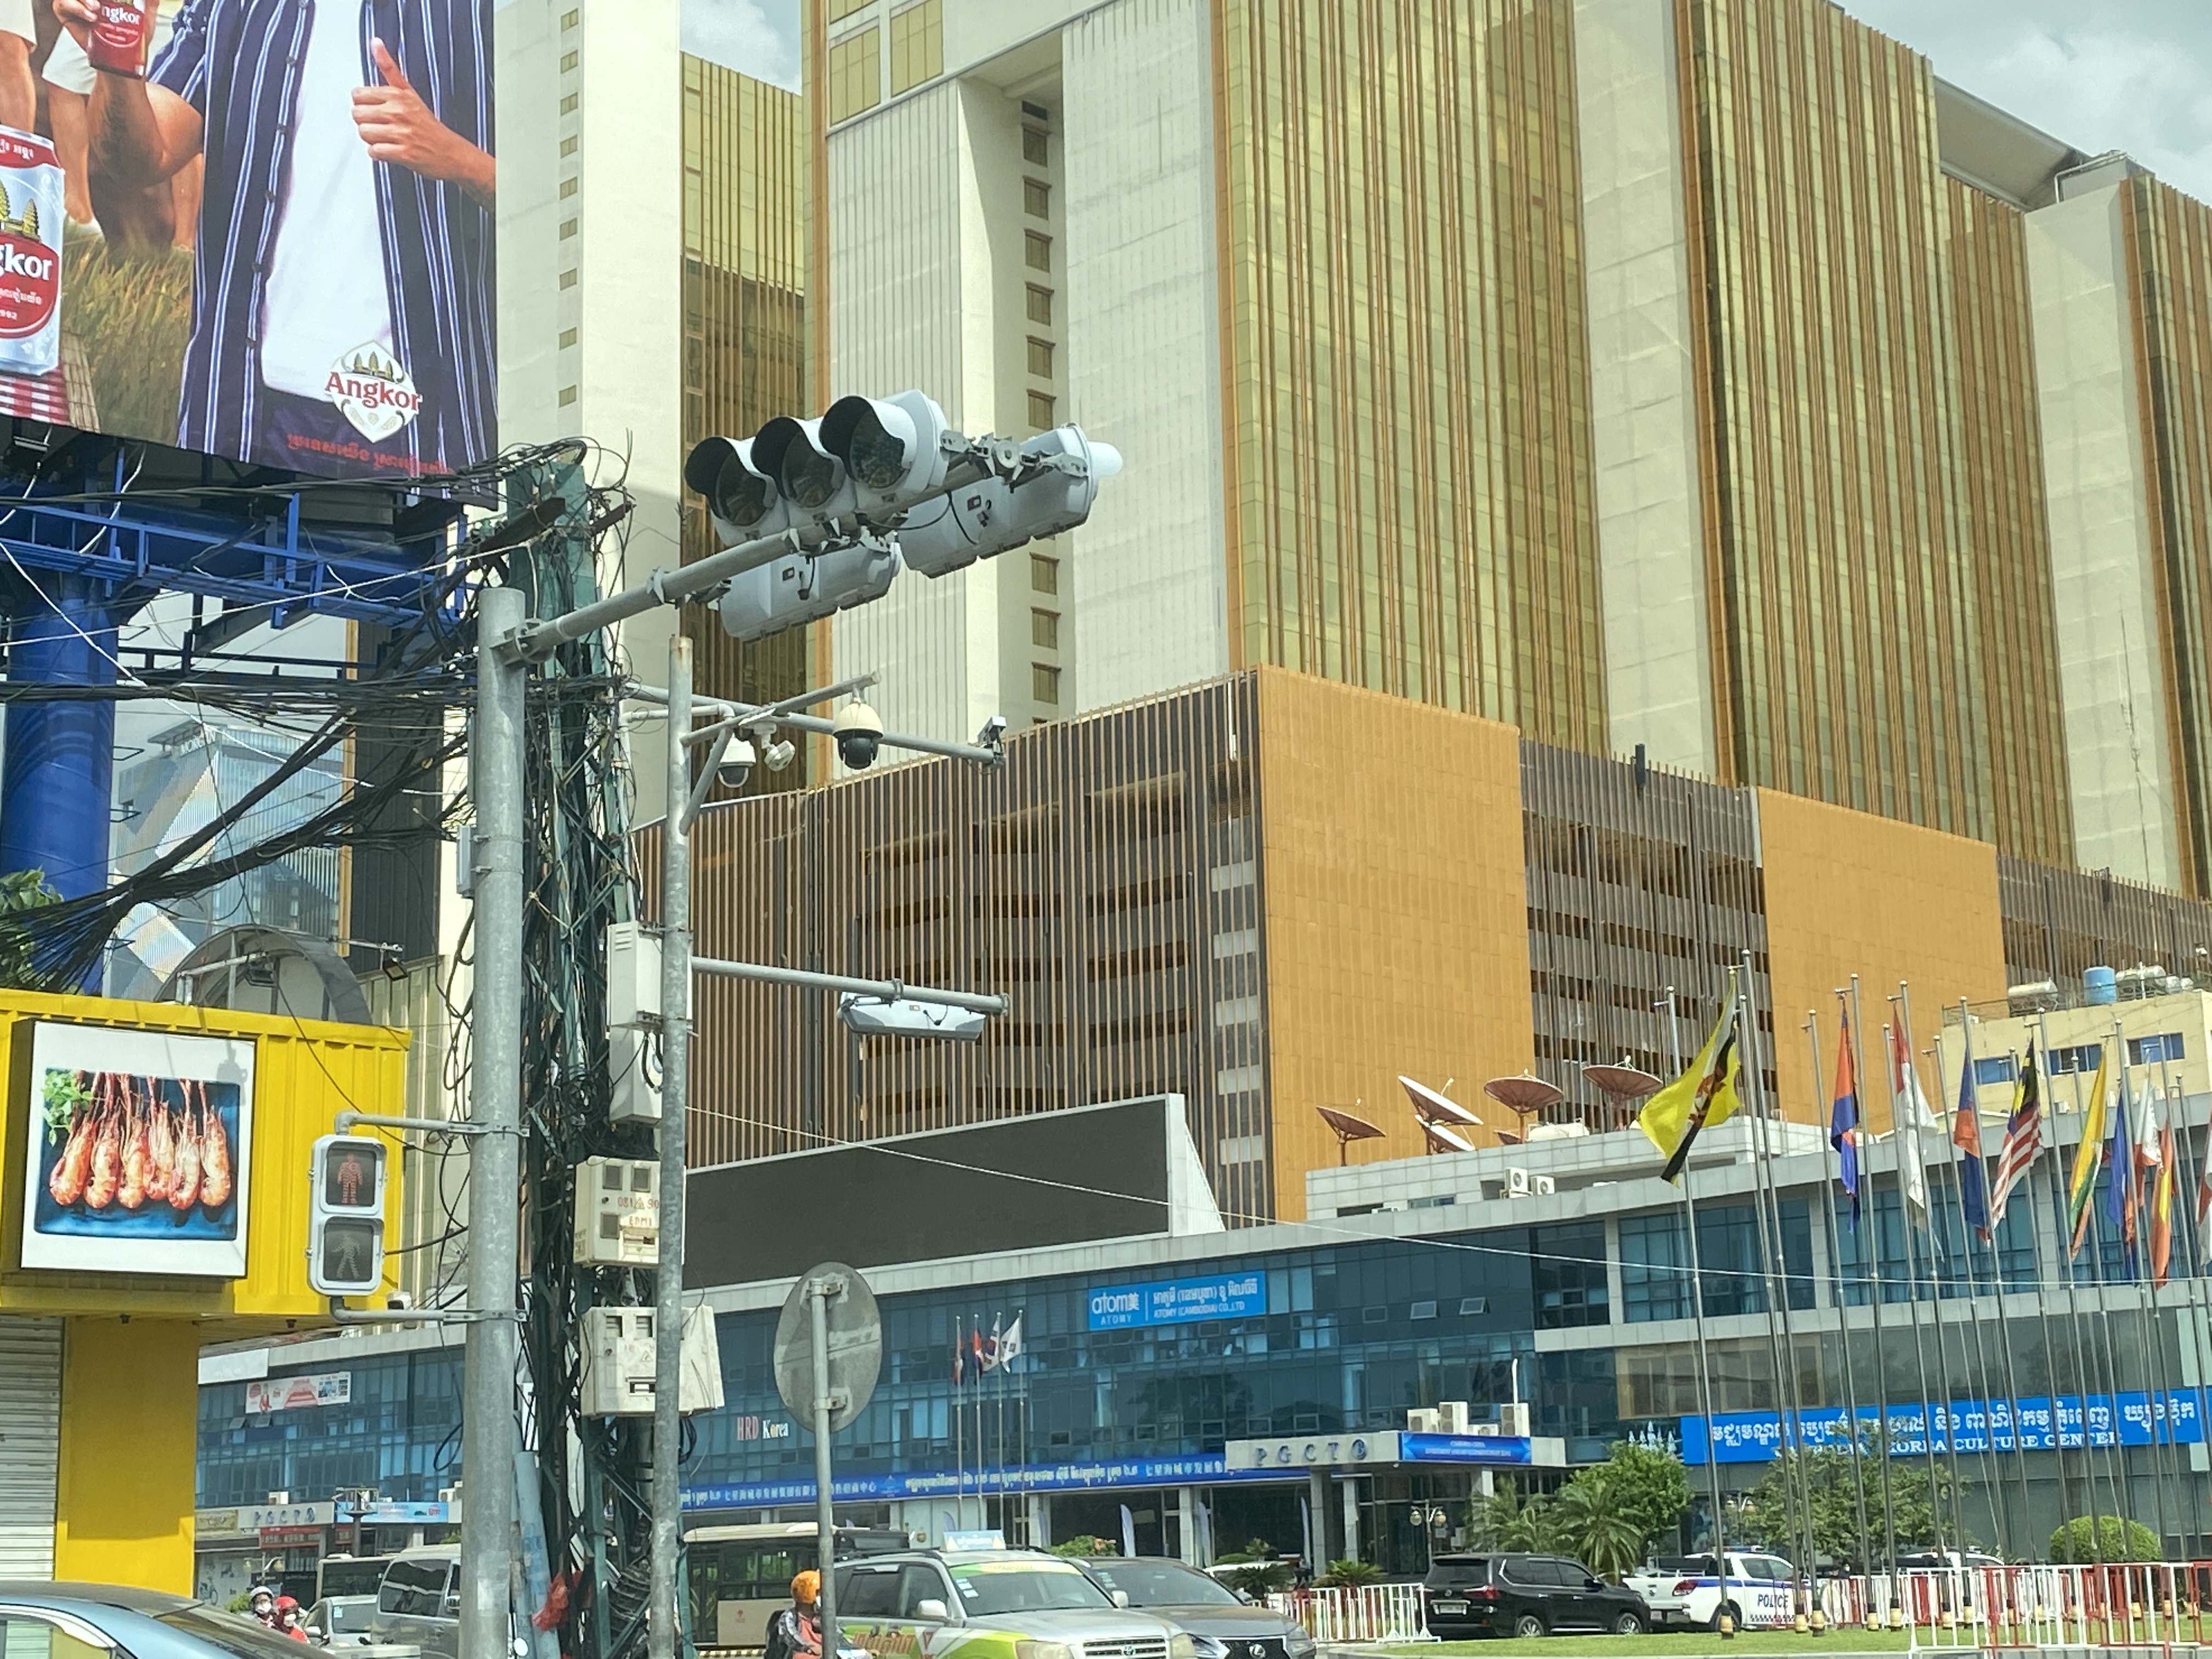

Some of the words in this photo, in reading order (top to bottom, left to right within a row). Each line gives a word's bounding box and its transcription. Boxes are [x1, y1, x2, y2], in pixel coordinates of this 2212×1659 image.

[101, 6, 140, 25] ngkor
[325, 371, 422, 411] Angkor
[1101, 1314, 1132, 1325] ATOMY
[1153, 1307, 1177, 1318] ATOMY
[737, 1416, 759, 1441] HRD
[762, 1419, 789, 1440] Korea
[1954, 1435, 2039, 1450] CULTURE
[2044, 1431, 2123, 1446] CENTER
[1757, 1593, 1789, 1608] POLICE
